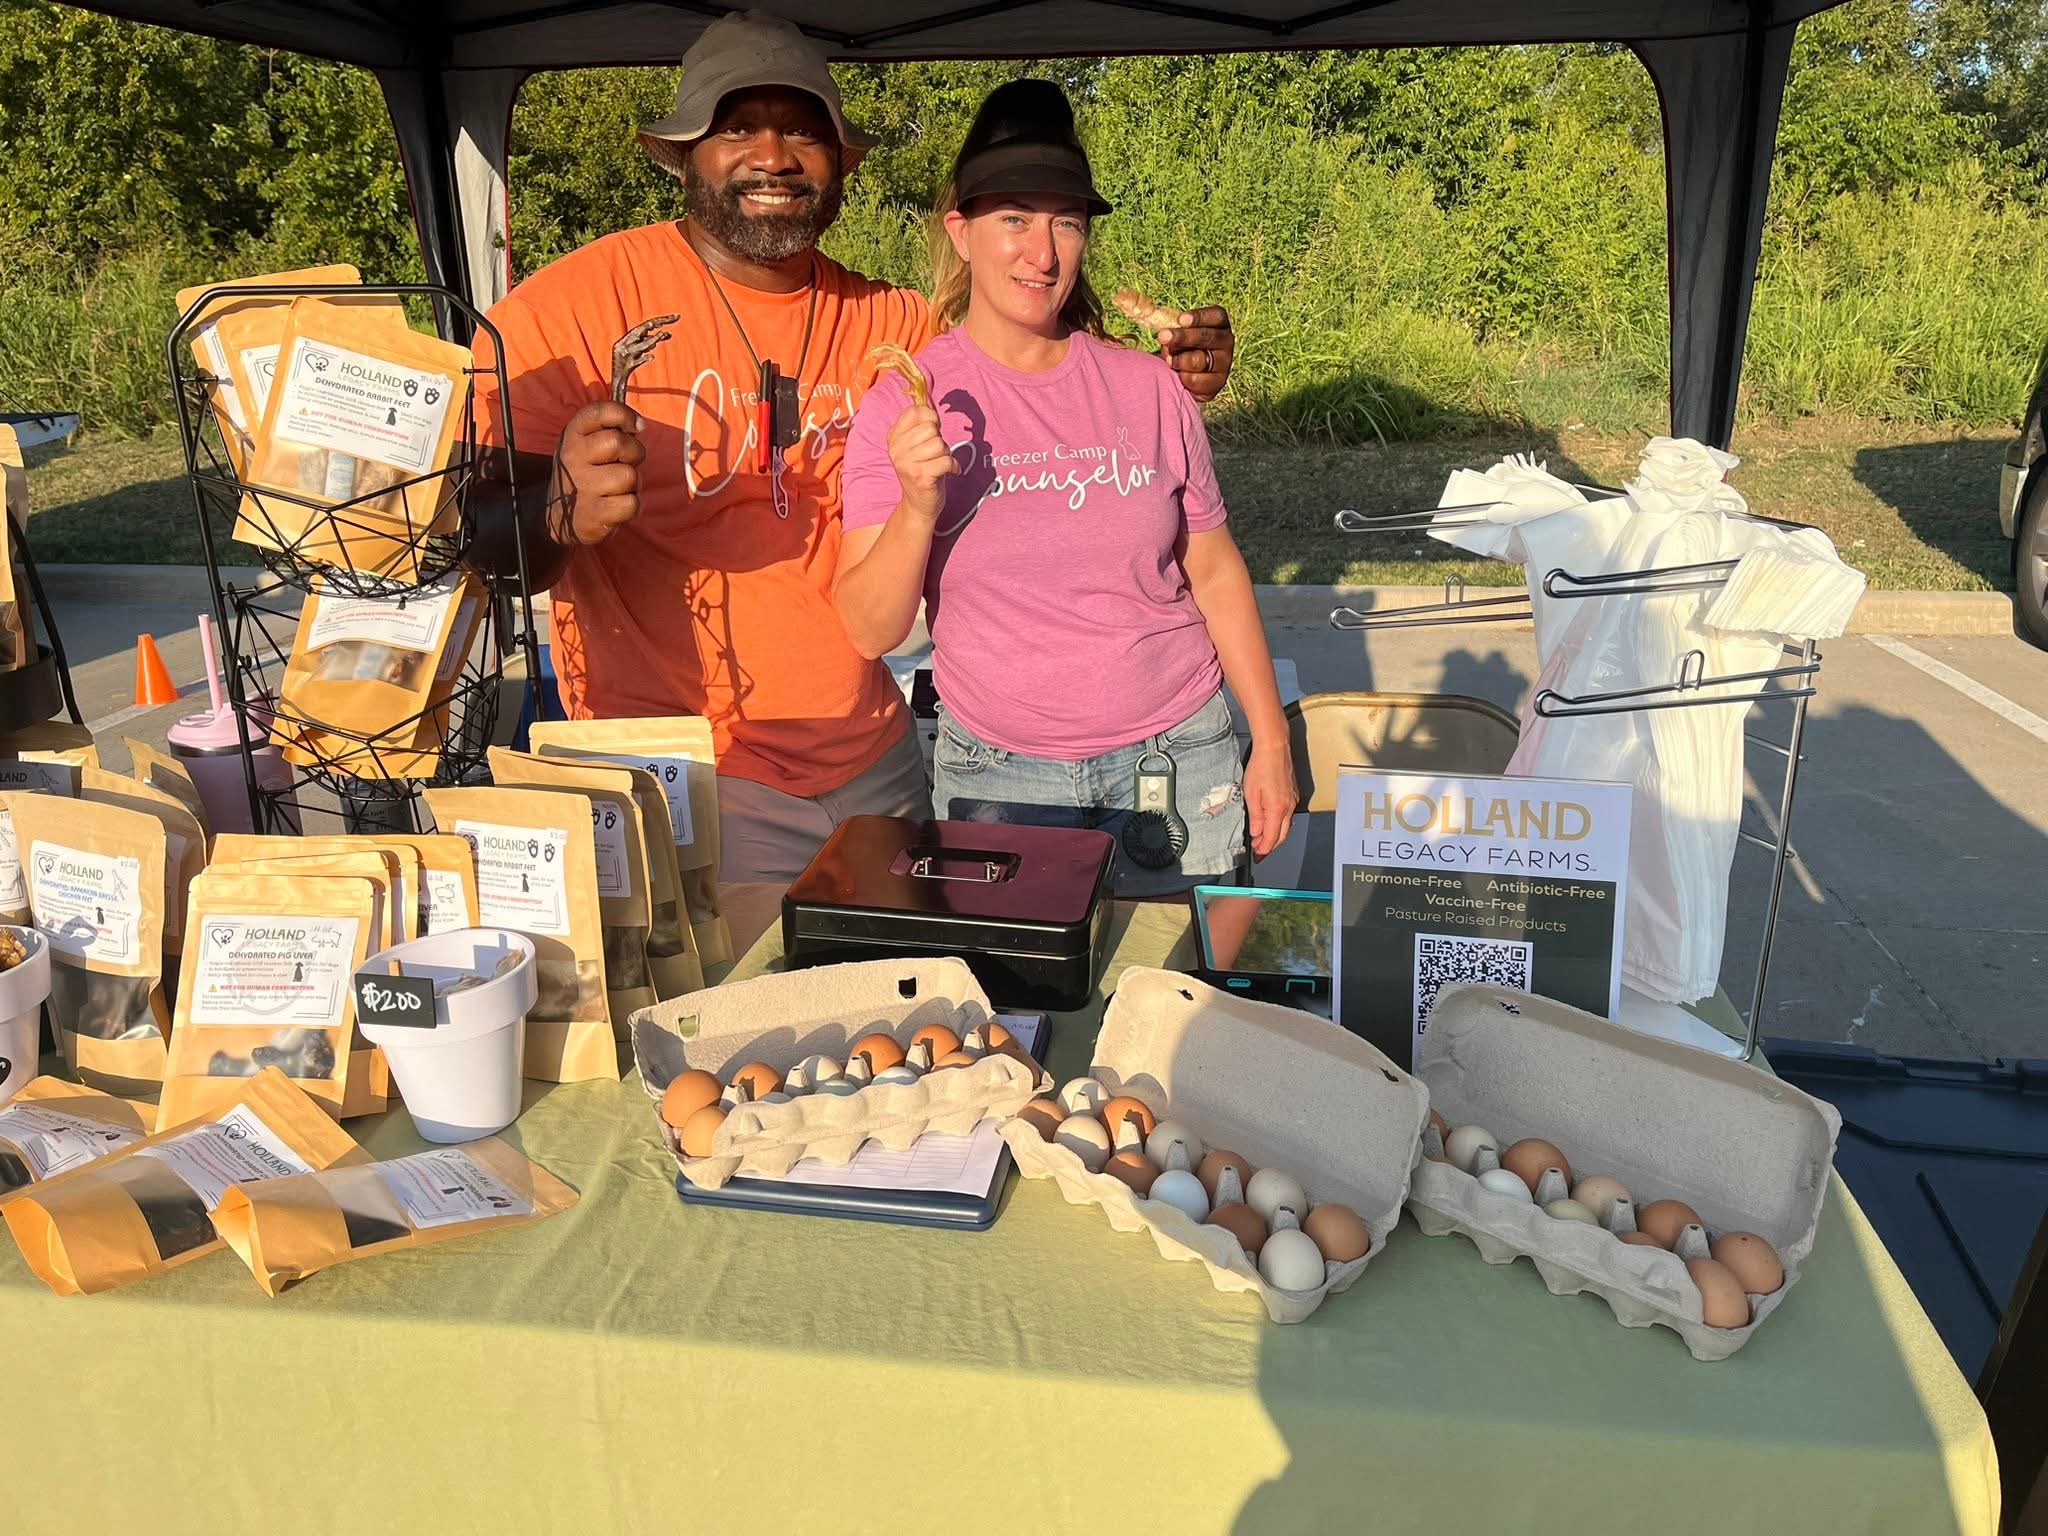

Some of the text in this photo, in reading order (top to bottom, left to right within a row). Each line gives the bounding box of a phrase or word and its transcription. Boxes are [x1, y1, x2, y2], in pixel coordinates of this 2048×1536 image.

[340, 362, 402, 389] HOLLAND
[315, 377, 411, 409] DEHYDRATED RABBIT FEET
[983, 443, 1107, 469] Freezer Camp
[0, 771, 28, 783] LAND
[1362, 791, 1593, 841] HOLLAND
[483, 835, 526, 851] HOLLAND
[1361, 840, 1591, 872] LEGACY FARMS
[59, 862, 104, 880] HOLLAND
[1352, 871, 1606, 899] Hormone-Free Antibiotic-Free
[1425, 893, 1527, 912] Vaccine-Free
[1385, 907, 1567, 932] Pasture Raised Products
[244, 928, 306, 941] HOLLAND
[228, 951, 276, 960] DEHYDRATED
[277, 951, 291, 960] PIG
[247, 1141, 291, 1175] HOLLAND
